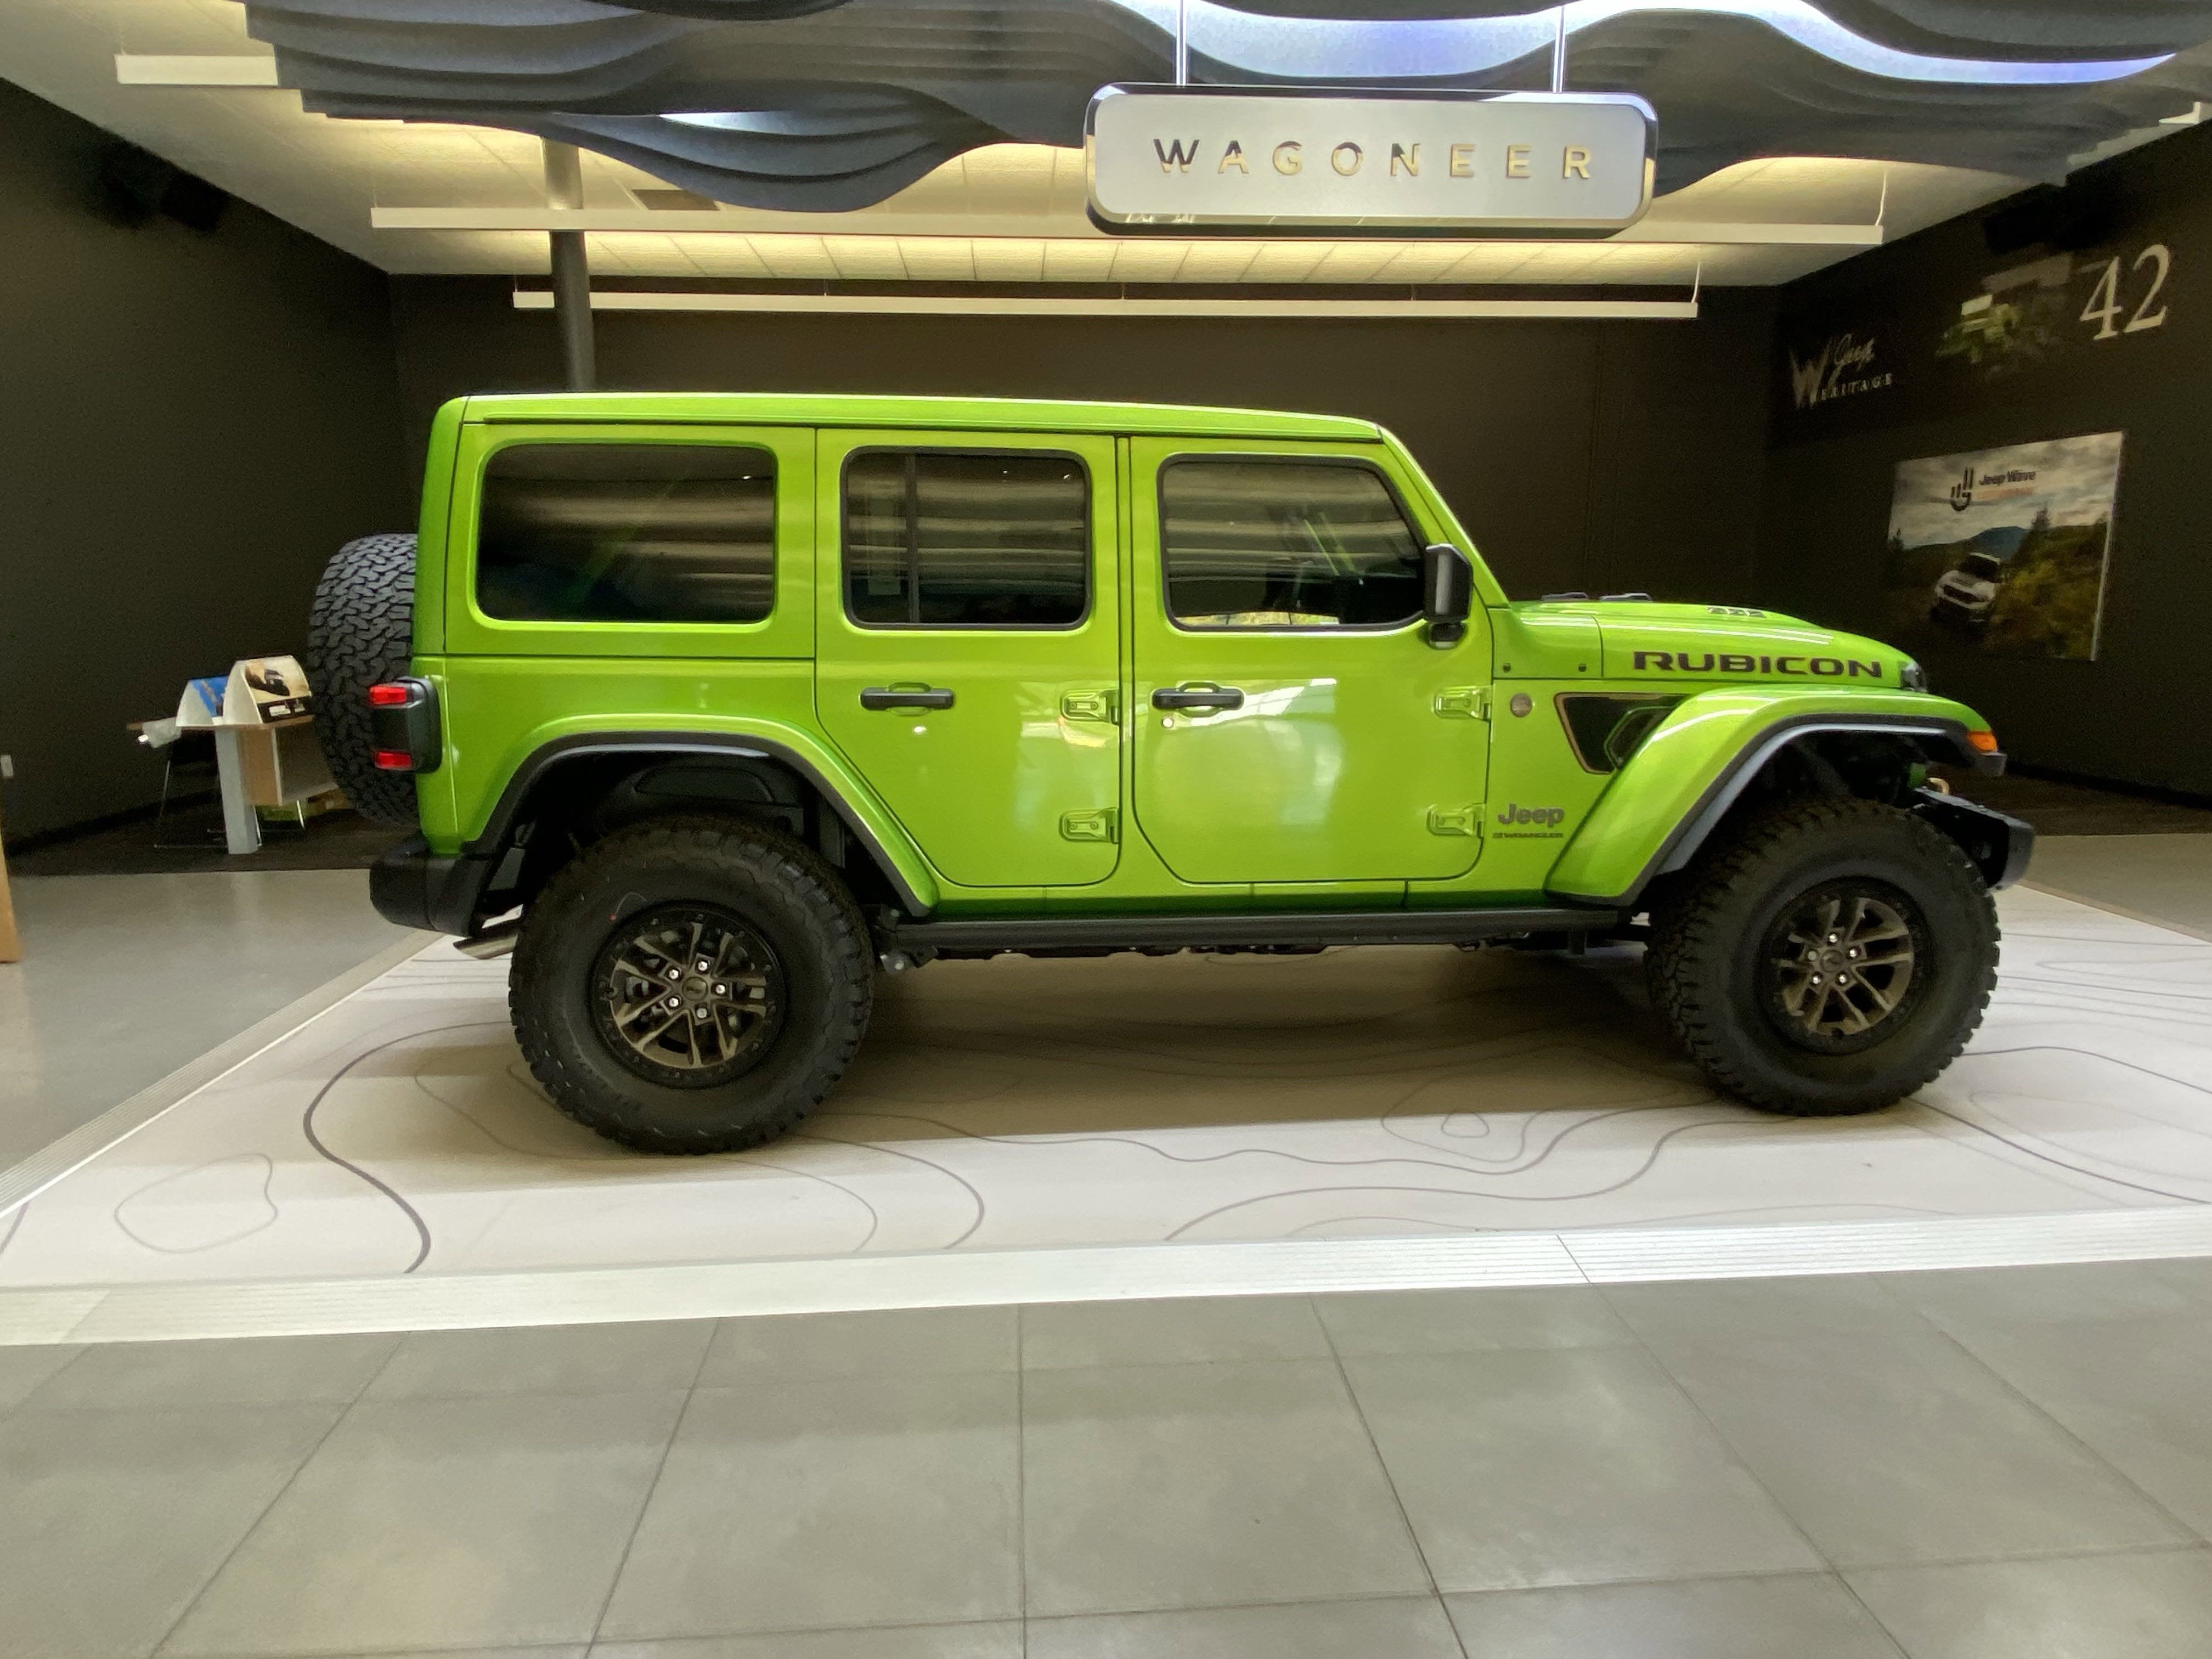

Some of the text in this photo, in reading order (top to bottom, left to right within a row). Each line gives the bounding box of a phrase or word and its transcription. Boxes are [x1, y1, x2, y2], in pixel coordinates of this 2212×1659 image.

[1153, 137, 1593, 180] WAGONEER
[2079, 242, 2170, 341] 42
[1979, 470, 2036, 486] Jeep Wave
[1633, 651, 1882, 678] RUBICON
[1497, 803, 1564, 828] Jeep
